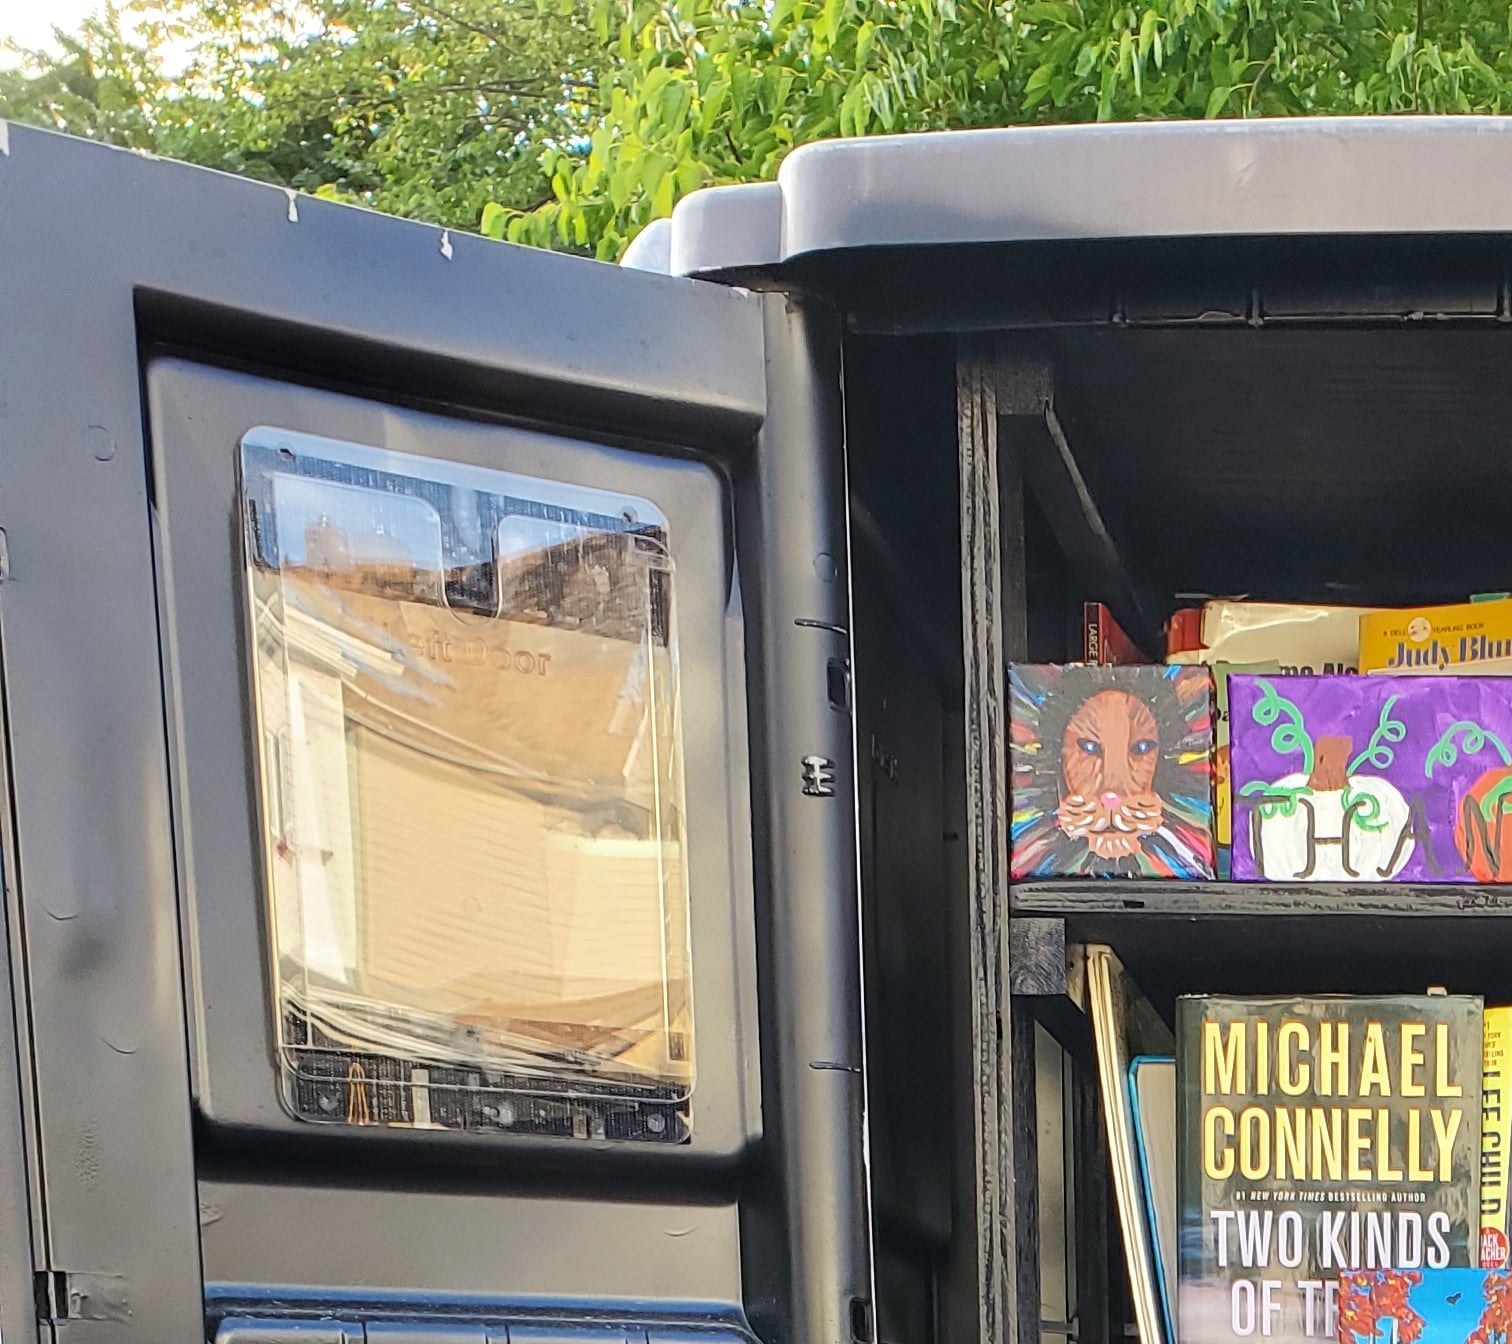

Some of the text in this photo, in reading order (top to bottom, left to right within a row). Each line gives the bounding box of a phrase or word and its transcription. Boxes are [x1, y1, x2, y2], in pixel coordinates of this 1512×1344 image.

[1087, 623, 1099, 659] LARGE
[1388, 639, 1450, 671] Judy
[1204, 1021, 1463, 1097] MICHAEL
[1204, 1105, 1463, 1183] CONNELLY
[1250, 1191, 1270, 1201] NEW
[1273, 1191, 1296, 1201] YORK
[1299, 1191, 1325, 1202] TIMES
[1328, 1191, 1388, 1203] BESTSELLING
[1391, 1192, 1426, 1203] AUTHOR
[1210, 1209, 1451, 1270] TWO KINDS
[1231, 1279, 1282, 1337] OF
